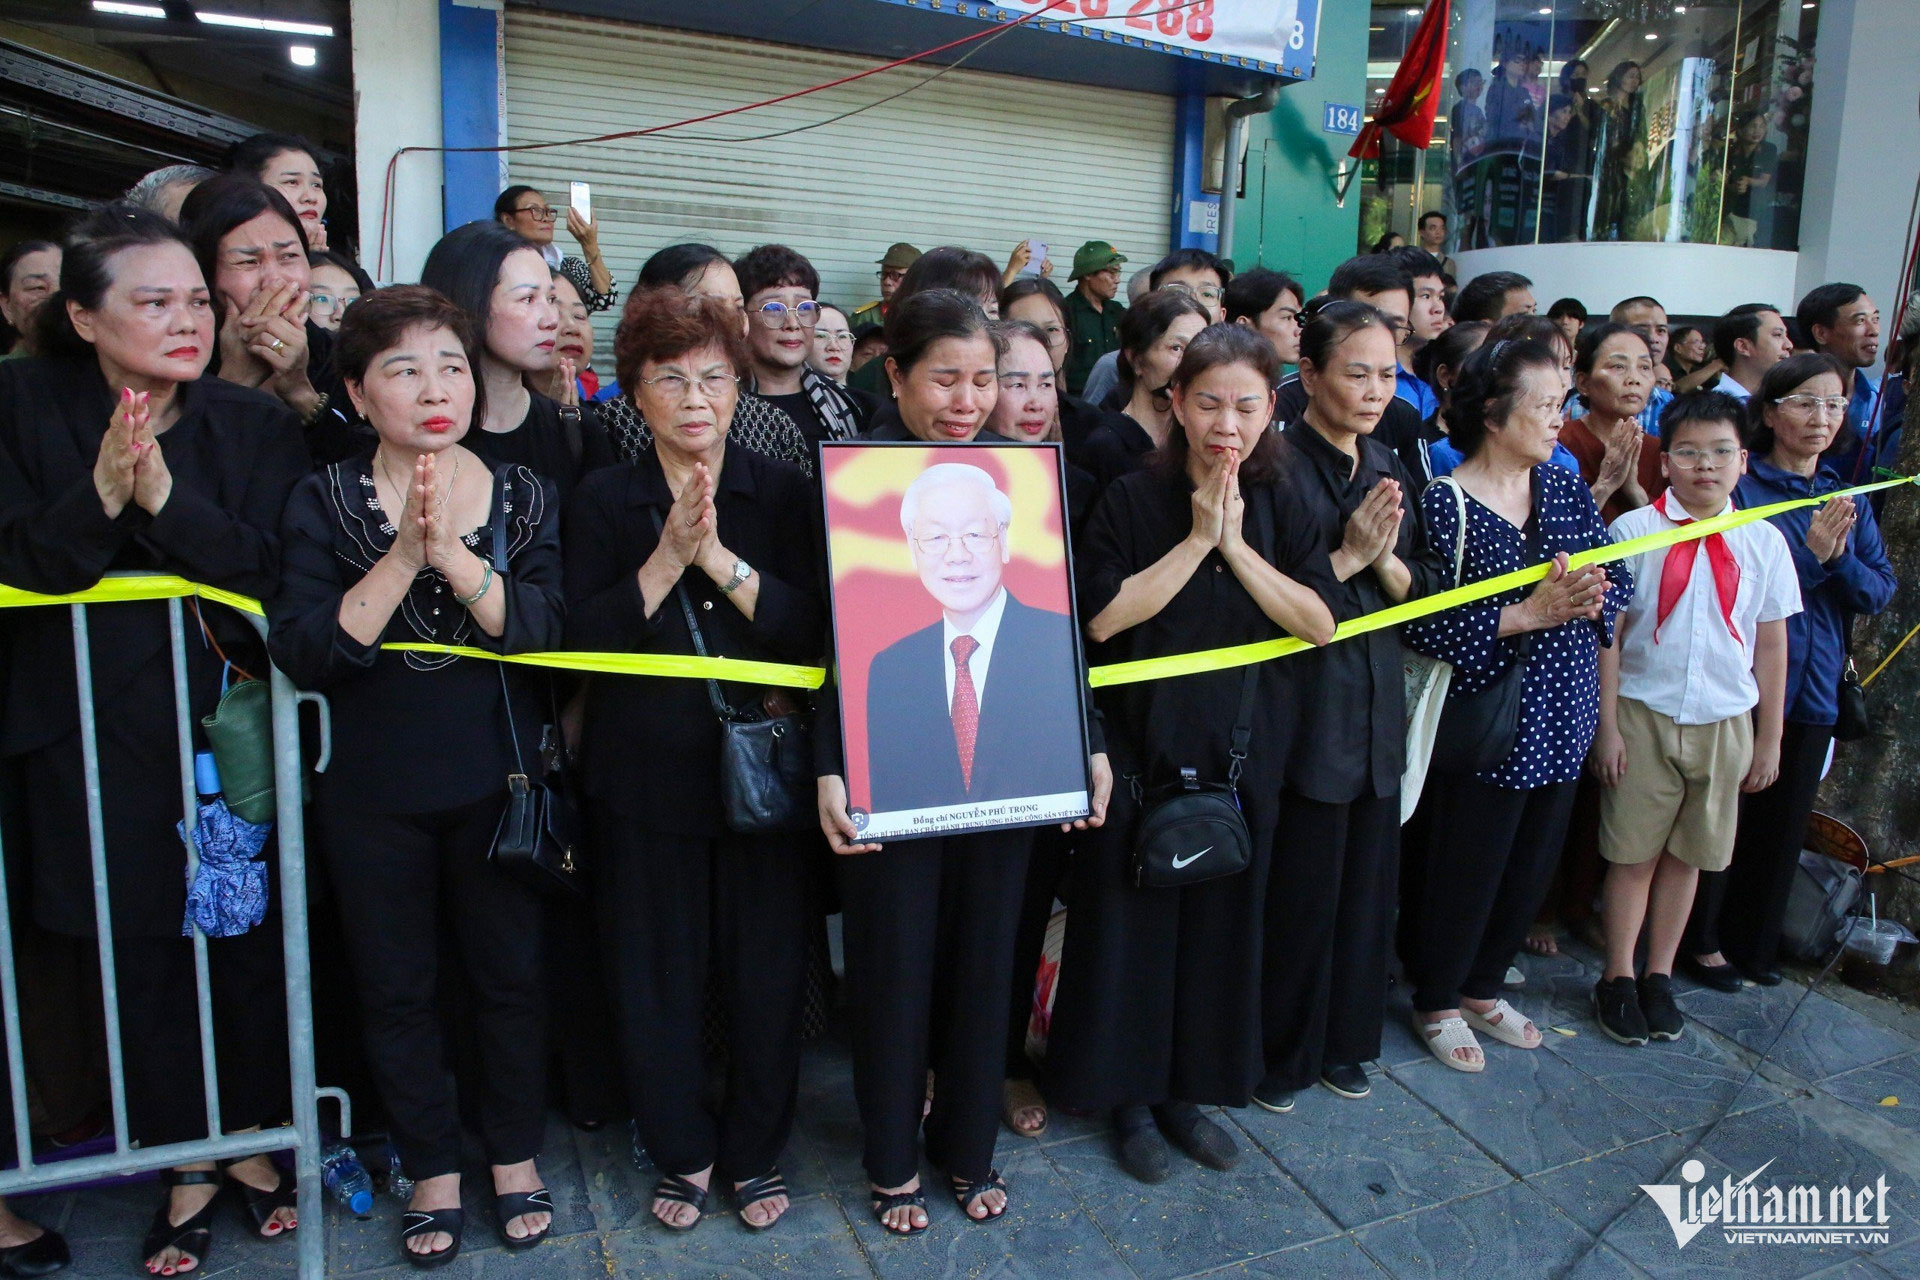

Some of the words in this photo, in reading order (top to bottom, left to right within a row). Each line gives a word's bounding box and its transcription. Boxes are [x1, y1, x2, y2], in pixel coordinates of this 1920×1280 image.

[1125, 0, 1214, 42] 288
[1328, 107, 1358, 131] 184
[860, 831, 880, 840] TỔNG
[880, 830, 888, 838] BÍ
[920, 824, 940, 833] CHẤP
[941, 822, 960, 831] HÀNH
[962, 821, 984, 829] TRUNG
[1025, 813, 1043, 821] CỘNG
[1044, 812, 1057, 820] SẢN
[913, 815, 934, 825] Đồng
[936, 813, 948, 822] chí
[950, 807, 986, 820] NGUYỄN
[988, 806, 1006, 816] PHÚ
[1009, 804, 1038, 814] TRỌNG
